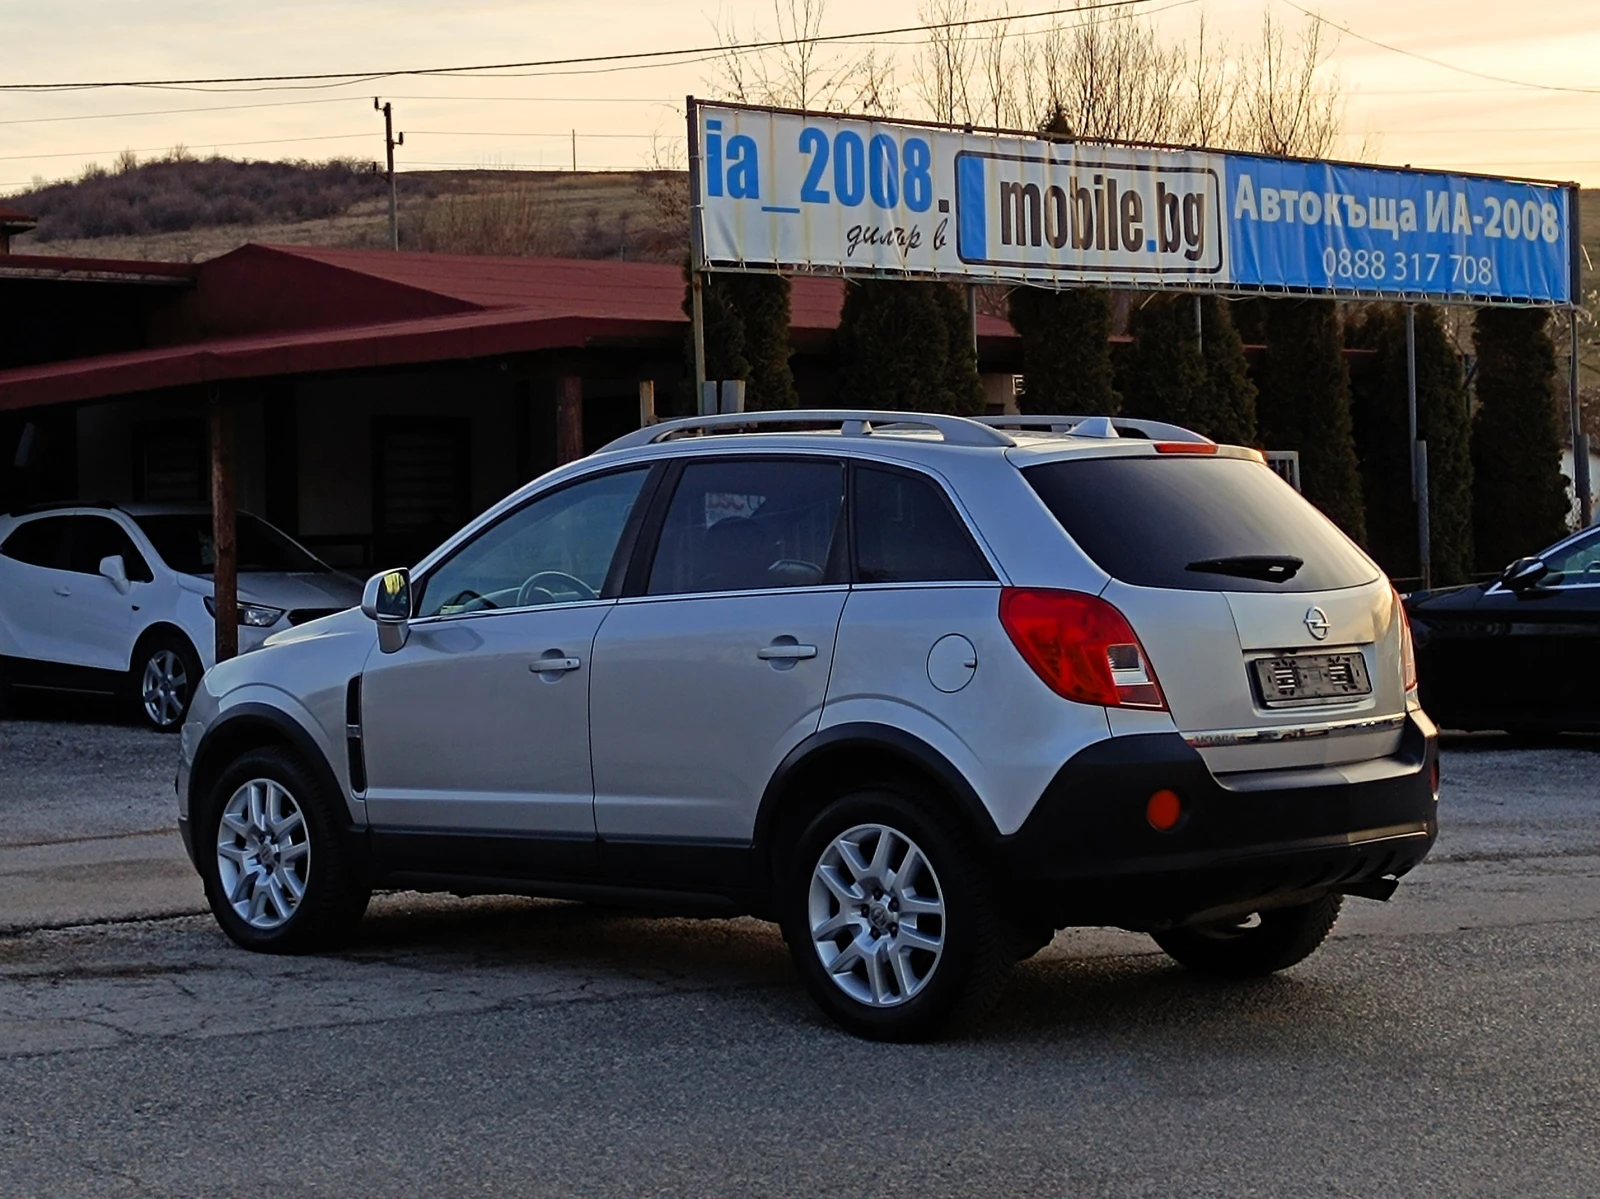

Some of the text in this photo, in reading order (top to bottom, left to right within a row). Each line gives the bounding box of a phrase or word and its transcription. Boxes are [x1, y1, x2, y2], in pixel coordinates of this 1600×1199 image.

[1000, 174, 1205, 261] mobile.bg
[1234, 173, 1559, 243] Автокъща ИА-2008
[1322, 247, 1492, 285] 0888 317 708
